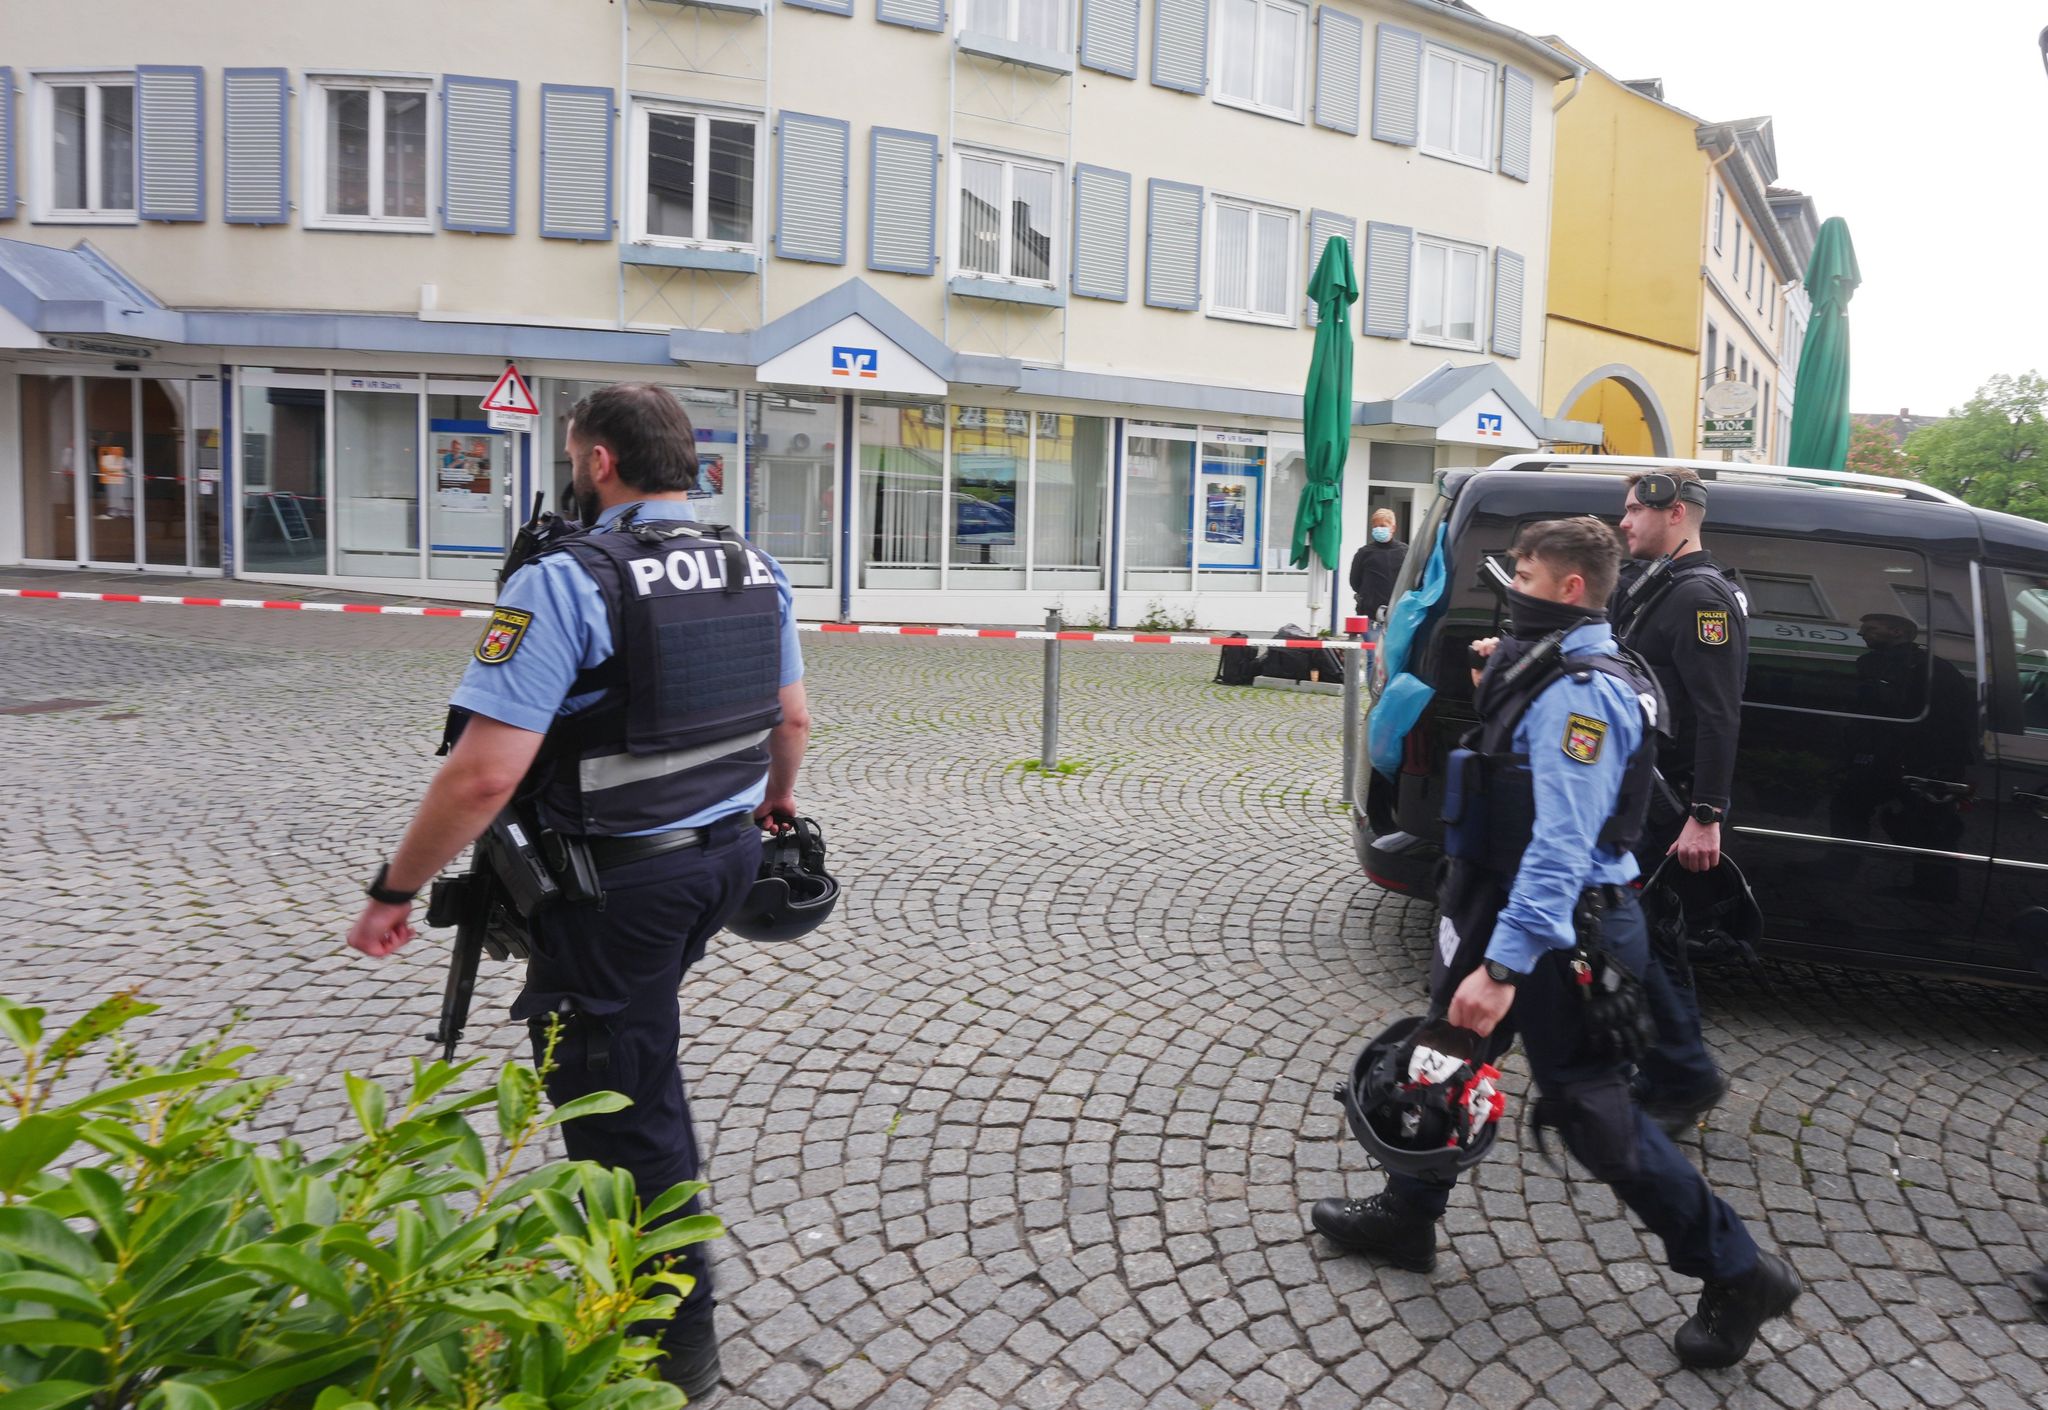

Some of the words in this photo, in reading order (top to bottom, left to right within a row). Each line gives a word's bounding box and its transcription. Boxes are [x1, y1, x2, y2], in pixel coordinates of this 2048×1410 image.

[381, 381, 402, 389] Bank
[1713, 420, 1745, 431] WOK
[628, 549, 777, 596] POLIE
